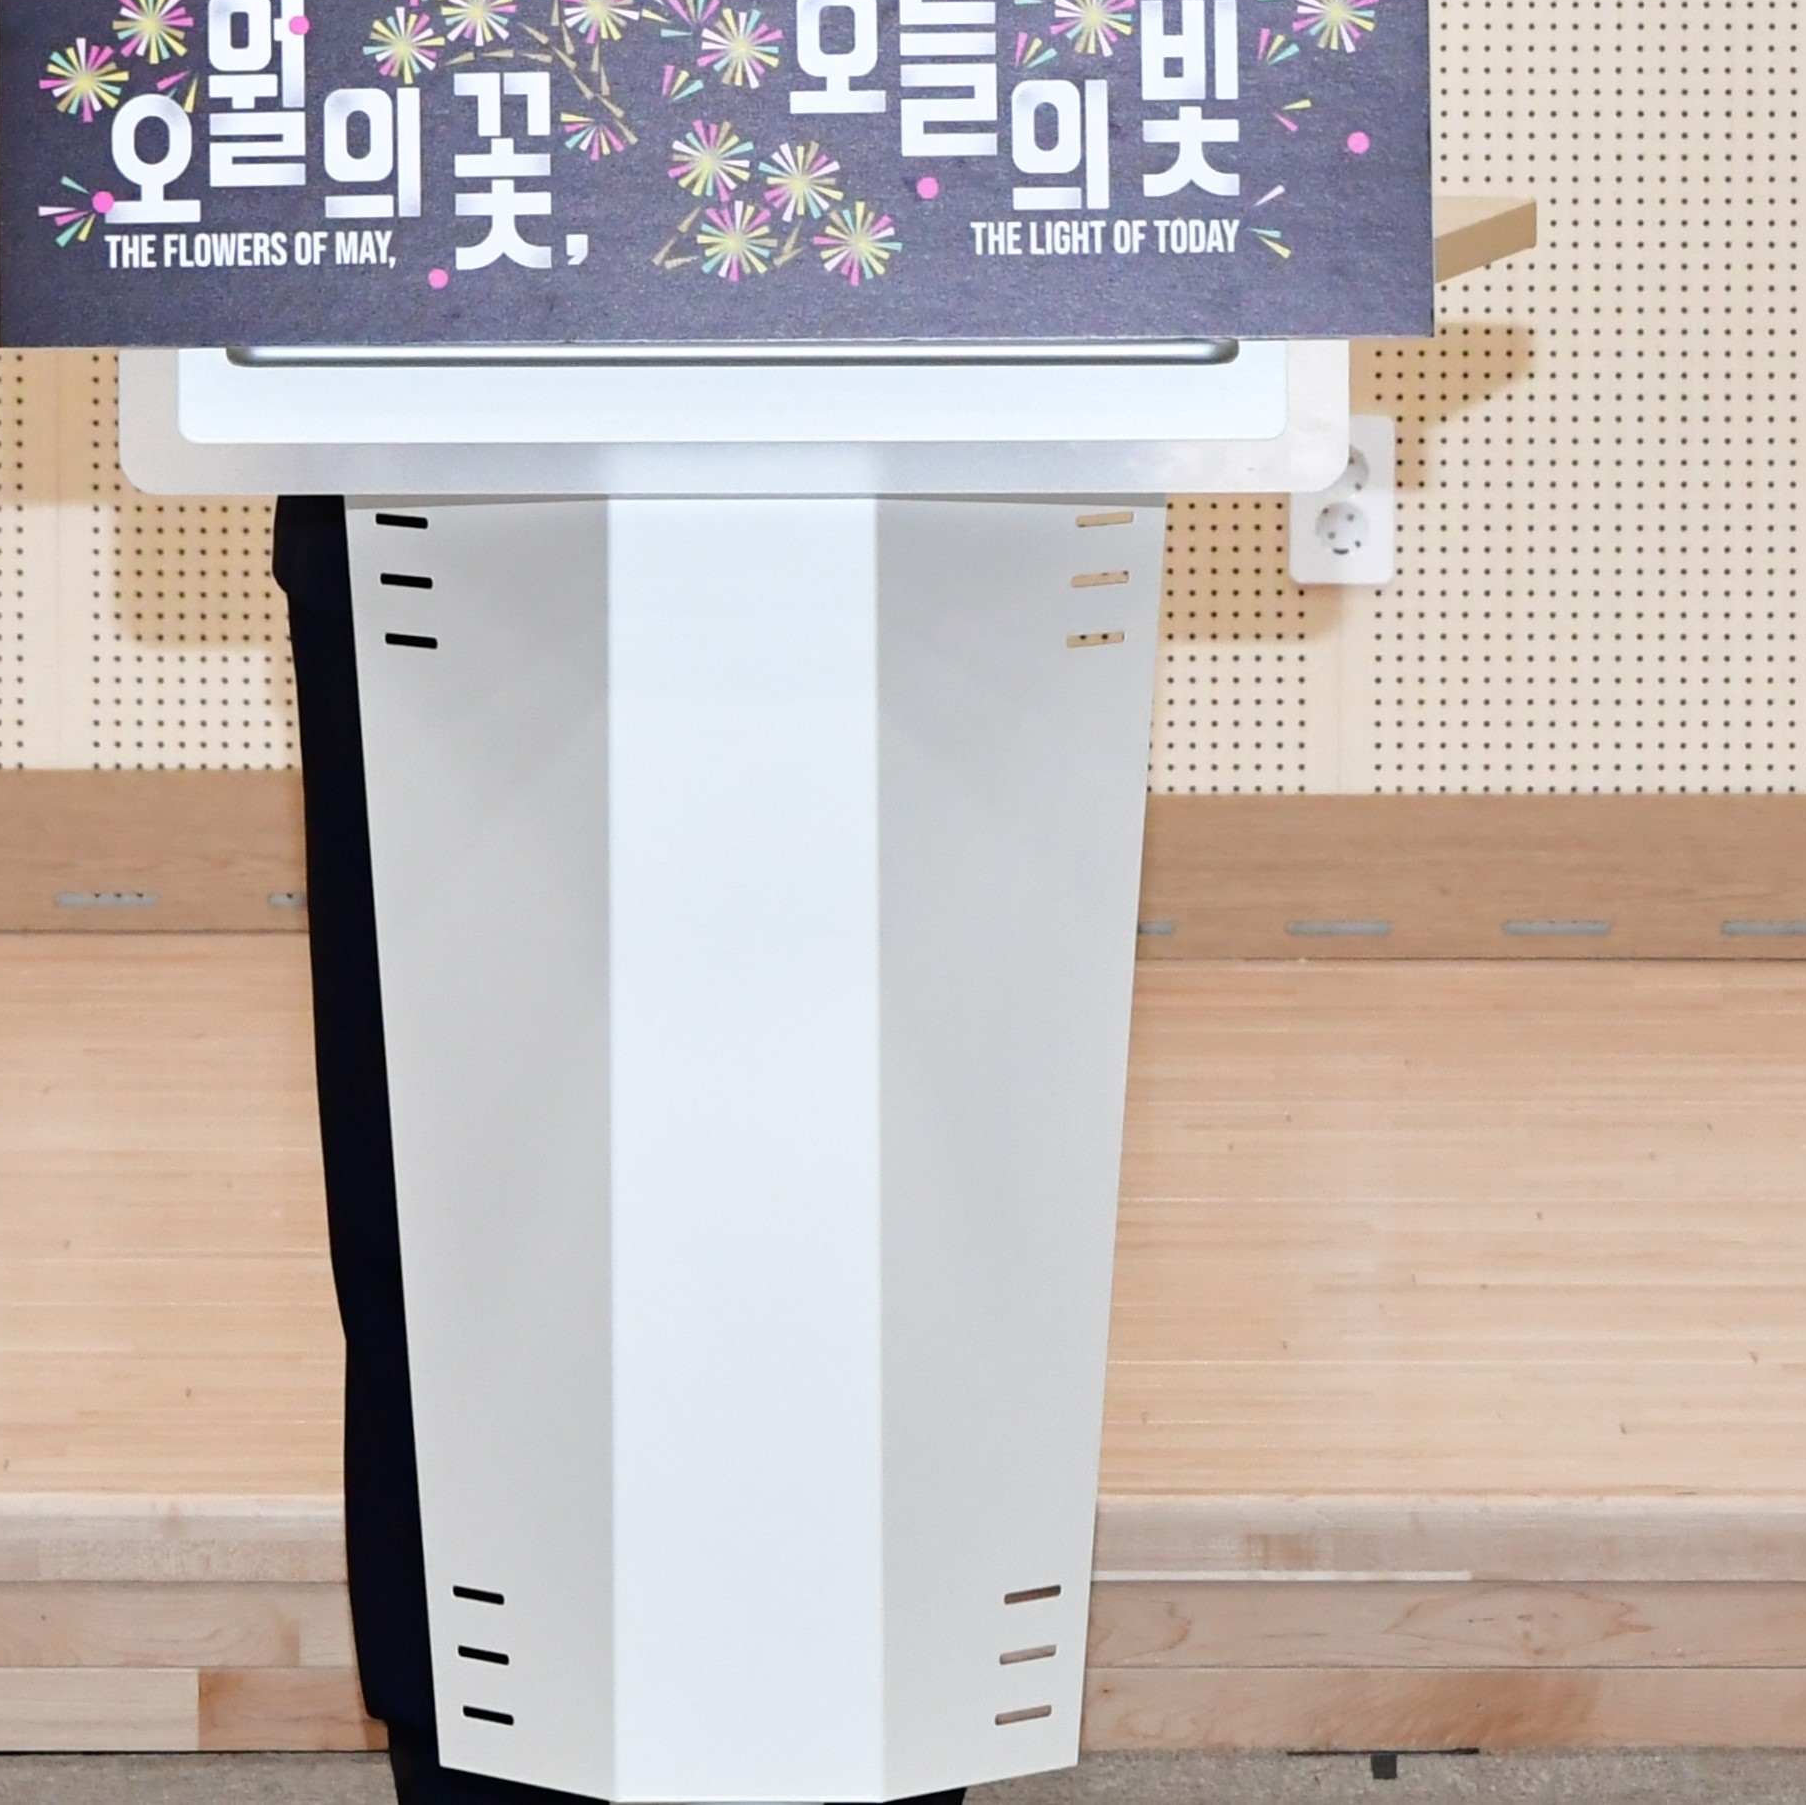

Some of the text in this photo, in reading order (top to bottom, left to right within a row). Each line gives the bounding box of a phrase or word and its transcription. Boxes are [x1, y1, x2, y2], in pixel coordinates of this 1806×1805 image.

[453, 71, 589, 271] 꽃,
[104, 230, 397, 270] THE FLOWERS OF MAY,
[970, 218, 1241, 256] THE LIGHT OF TODAY
